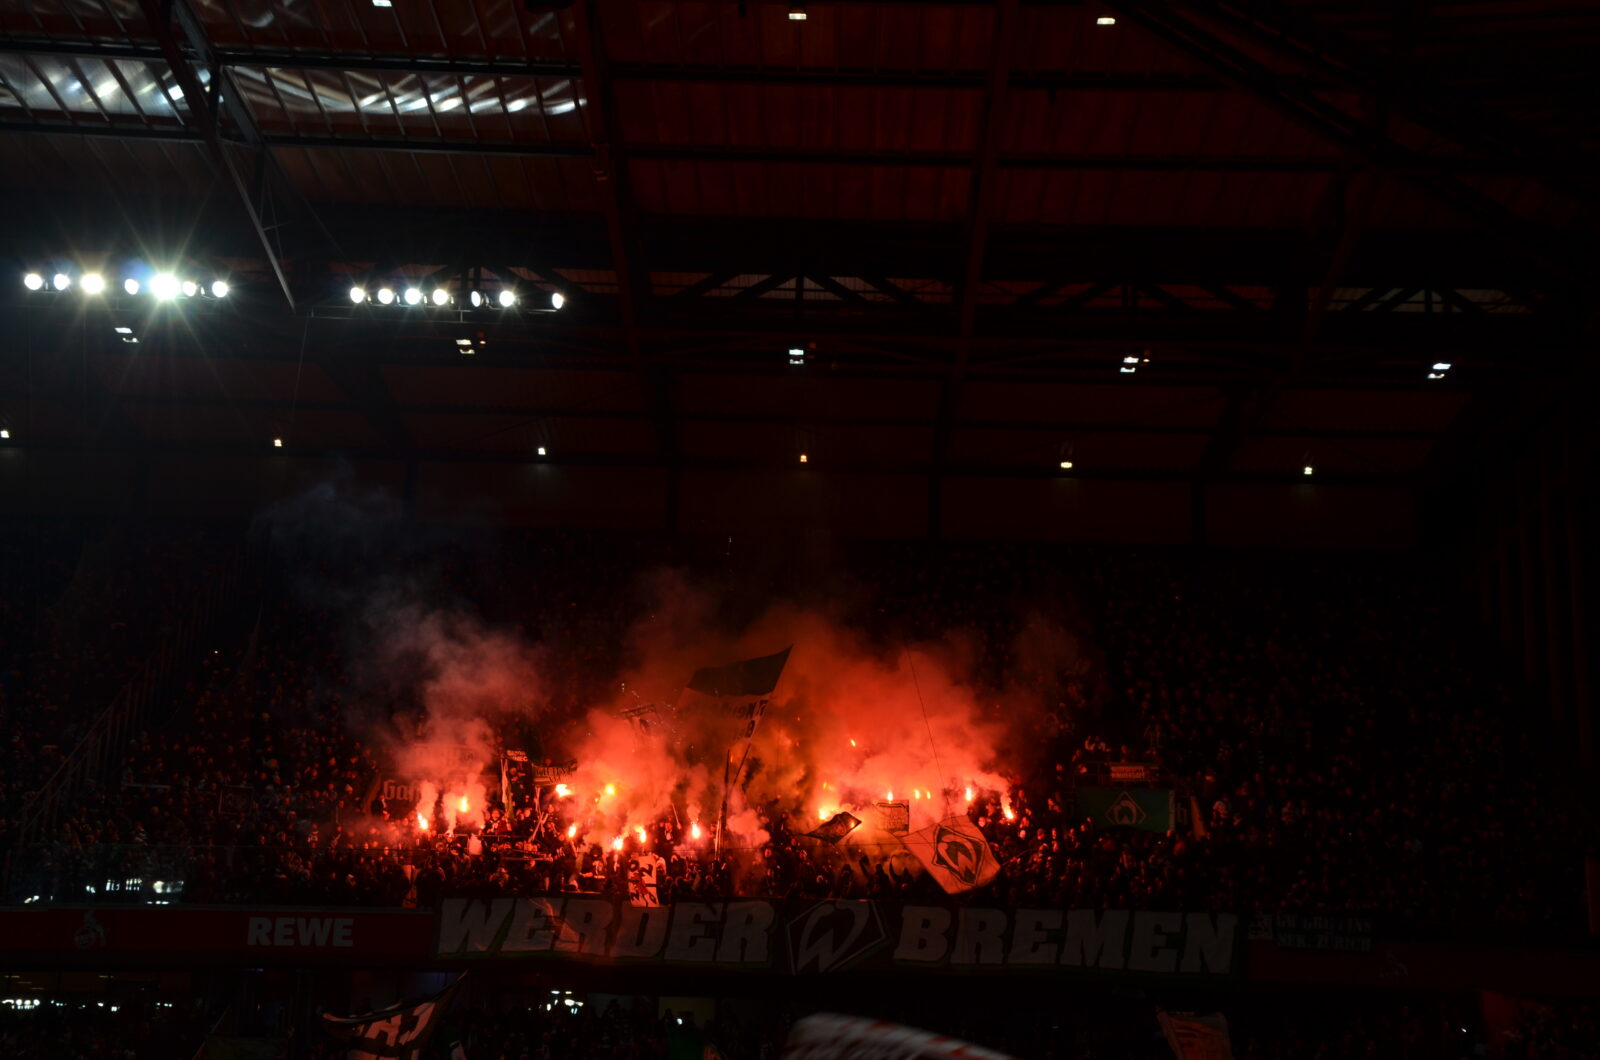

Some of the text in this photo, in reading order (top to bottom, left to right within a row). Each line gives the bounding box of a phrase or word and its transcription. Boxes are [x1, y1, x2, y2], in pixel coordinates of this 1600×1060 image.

[246, 916, 354, 948] REWE
[438, 896, 776, 963] WERDER
[893, 904, 1239, 975] BREMEN
